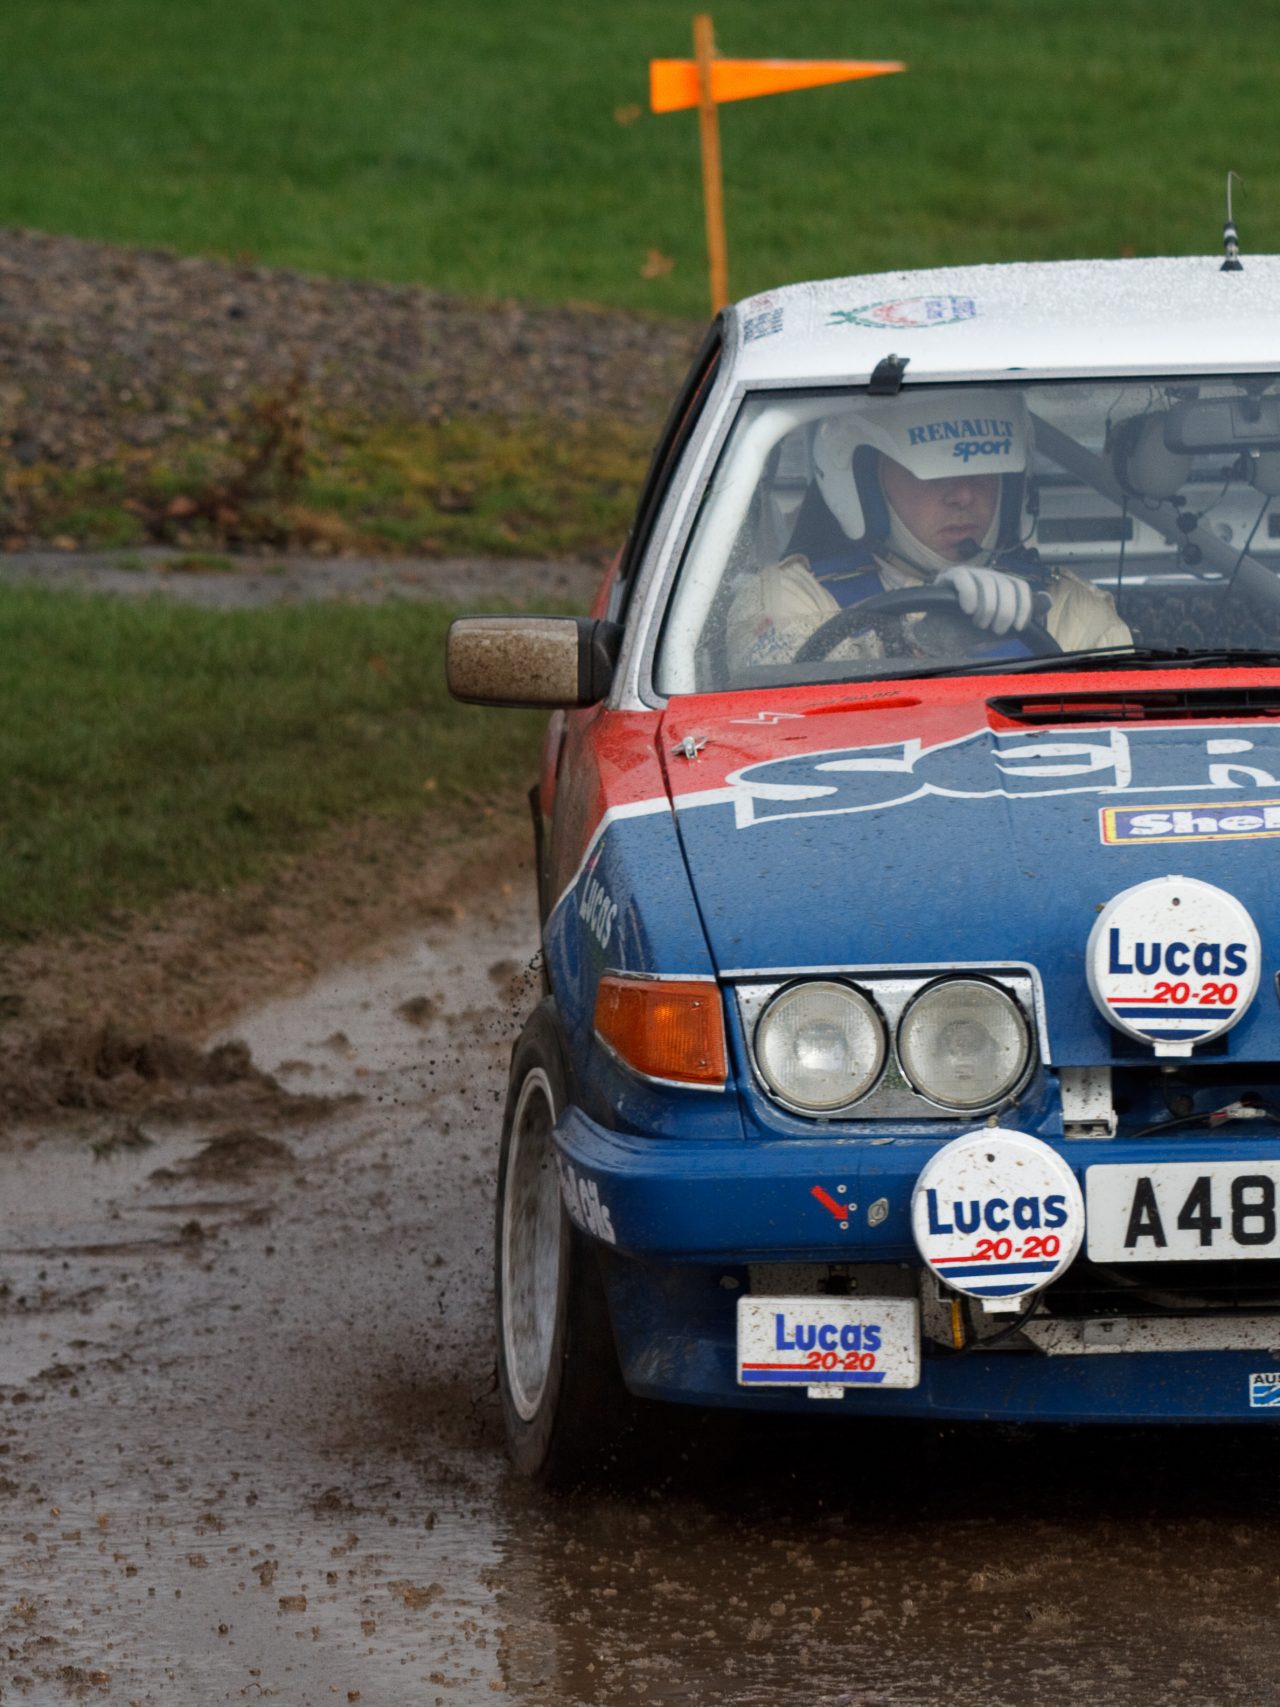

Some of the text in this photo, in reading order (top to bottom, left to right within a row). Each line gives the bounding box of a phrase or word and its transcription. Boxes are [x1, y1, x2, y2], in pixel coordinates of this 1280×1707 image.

[907, 419, 1014, 446] RENAULT
[952, 439, 1012, 463] sport
[1109, 928, 1248, 976] Lucas
[1153, 981, 1238, 1005] 20-20
[927, 1187, 1068, 1235] Lucas
[972, 1234, 1060, 1260] 20-20
[775, 1313, 882, 1352] Lucas
[805, 1351, 875, 1371] 20-20
